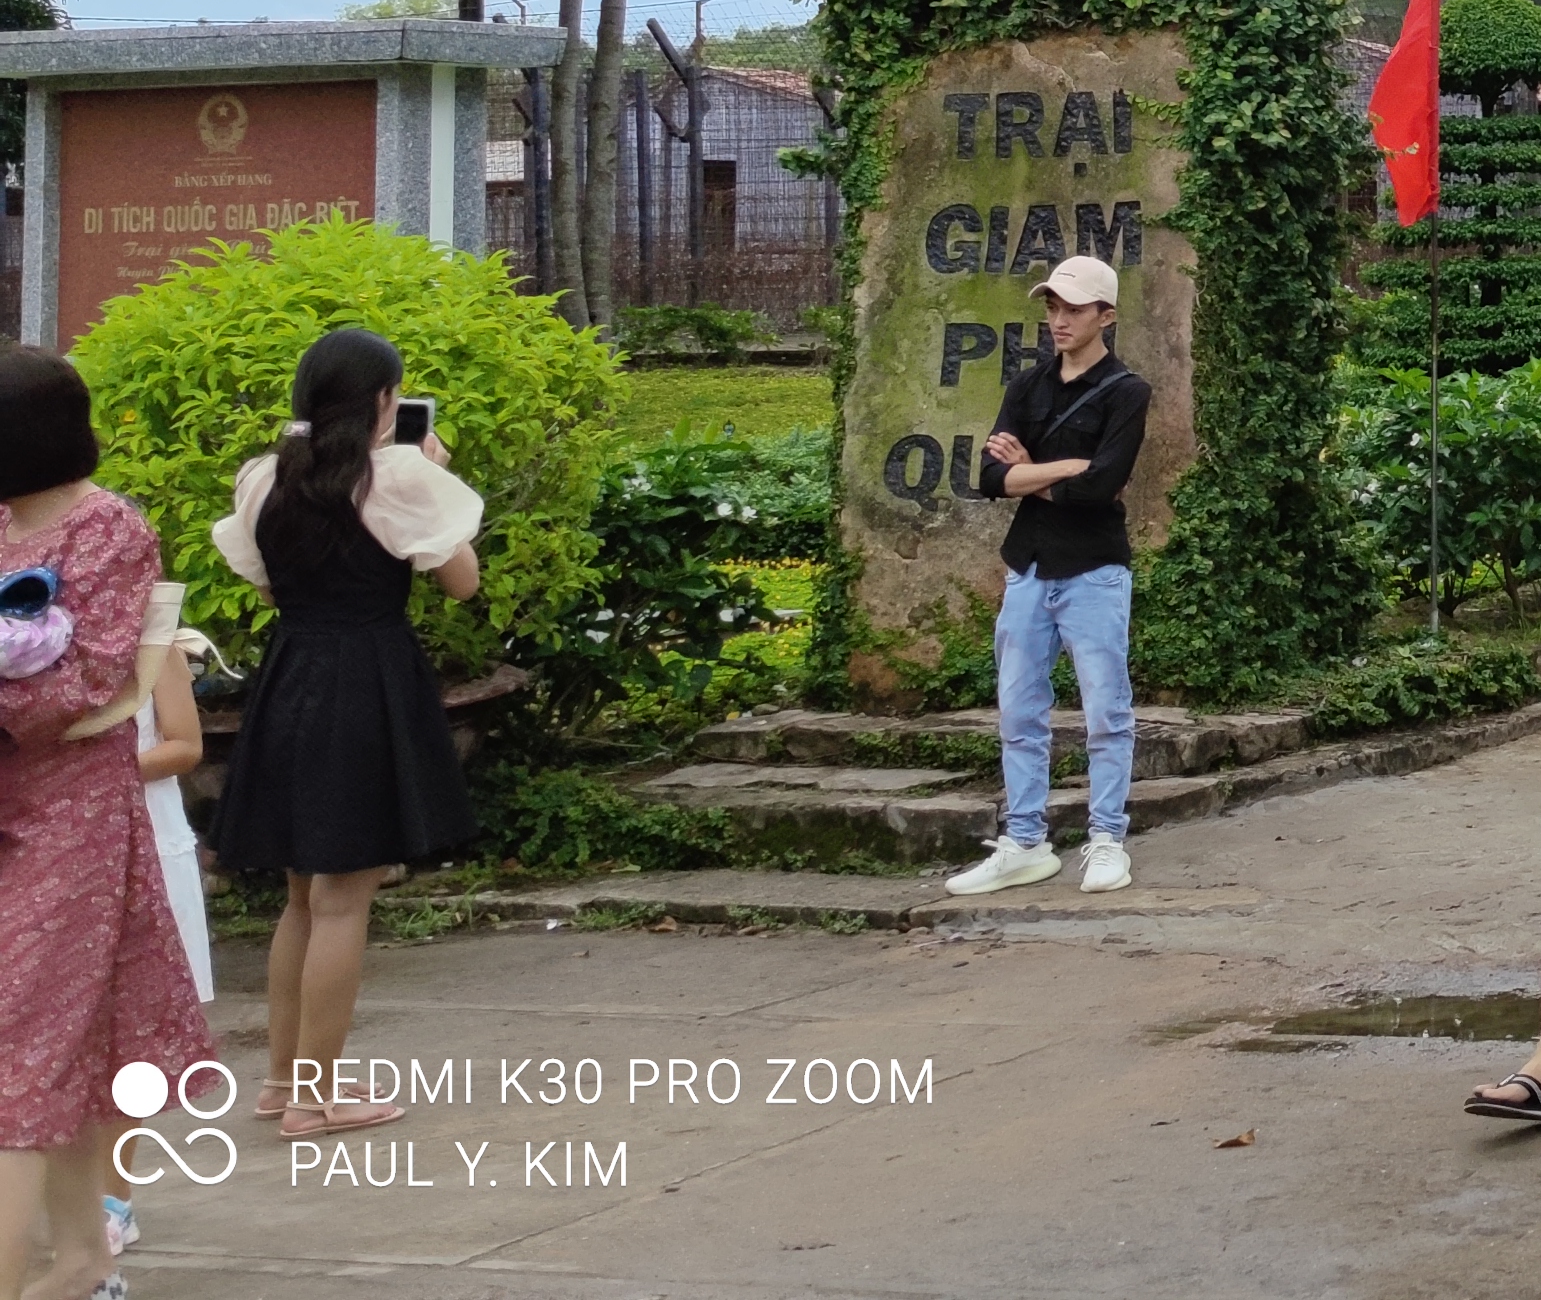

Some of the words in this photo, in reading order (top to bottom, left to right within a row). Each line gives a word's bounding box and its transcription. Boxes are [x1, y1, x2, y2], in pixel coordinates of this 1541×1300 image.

[943, 92, 1133, 177] TRẠI
[211, 170, 234, 187] XẾP
[237, 173, 272, 188] HẠNG
[84, 208, 103, 234] DI
[111, 201, 155, 233] TÍCH
[163, 196, 217, 233] QUỐC
[225, 204, 258, 231] GIA
[926, 201, 1142, 274] GIAM
[940, 322, 1118, 388] PH
